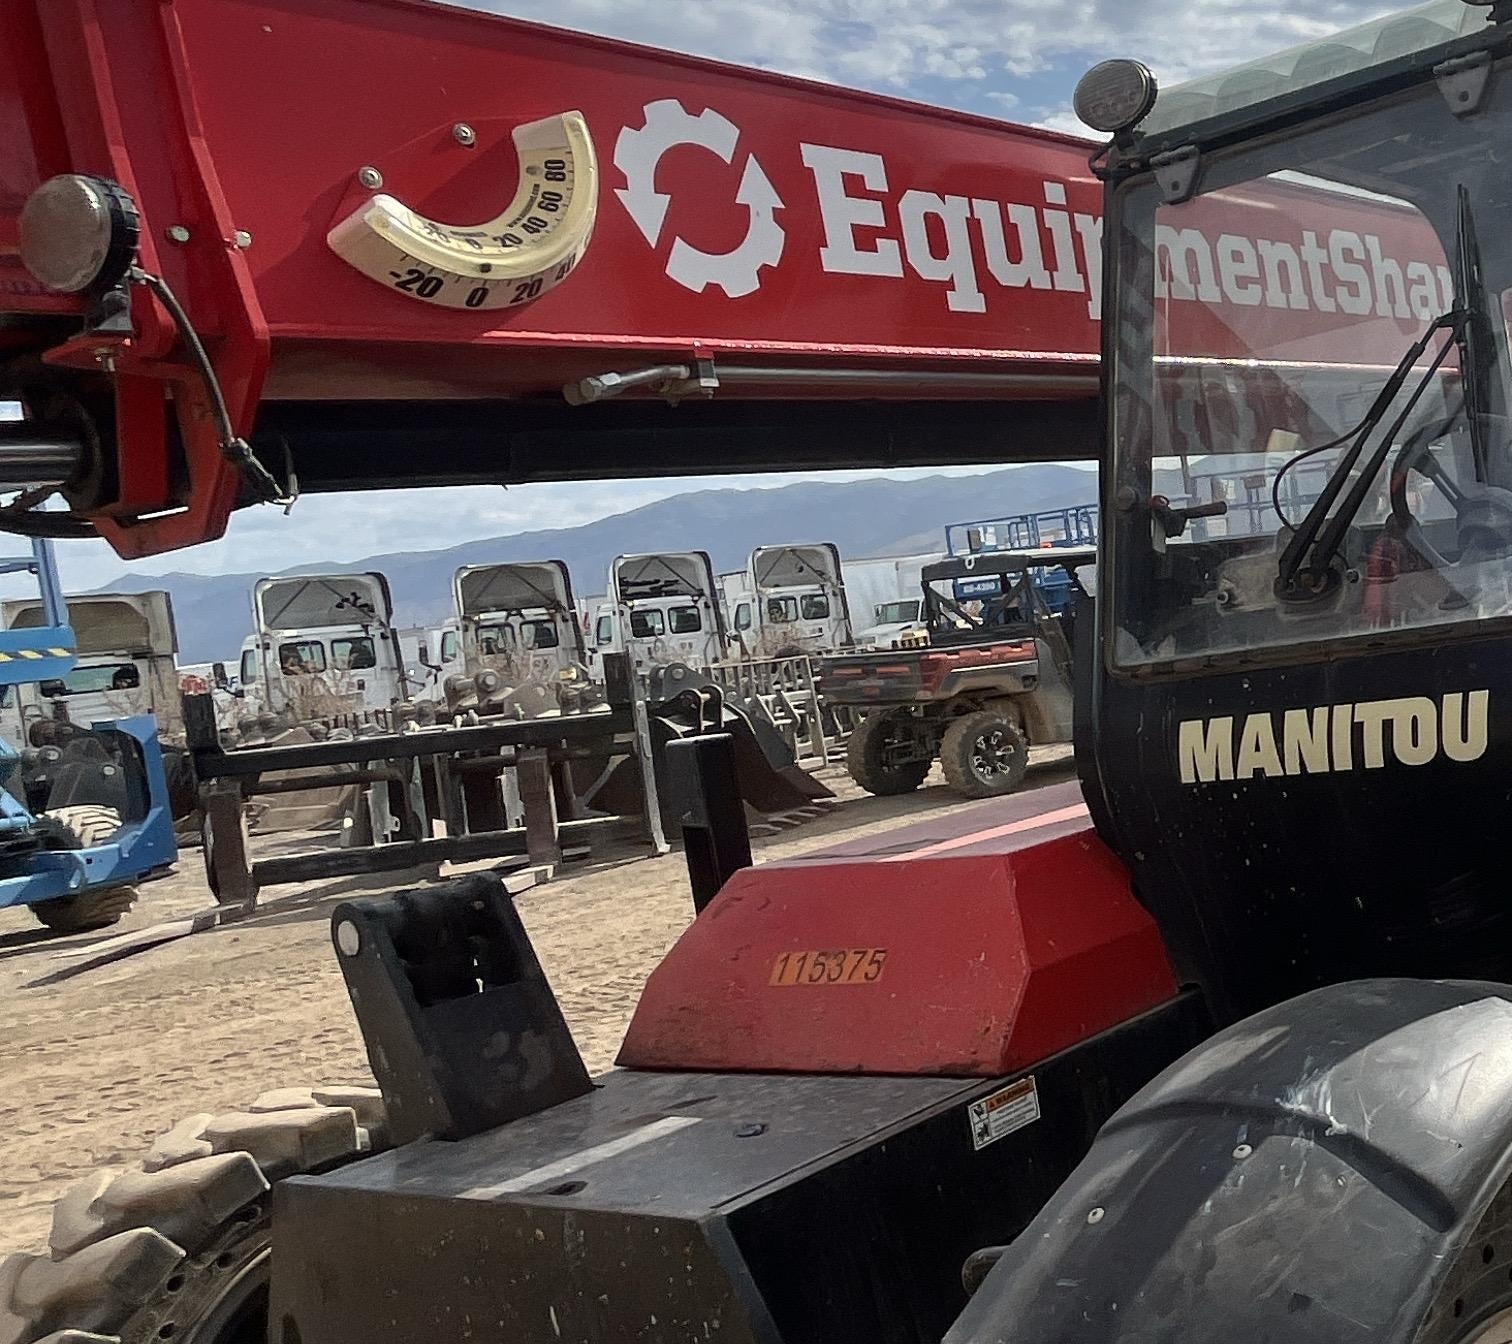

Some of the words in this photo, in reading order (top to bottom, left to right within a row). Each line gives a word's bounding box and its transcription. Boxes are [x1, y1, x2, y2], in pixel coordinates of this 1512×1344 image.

[544, 159, 566, 182] 80
[537, 190, 563, 213] 60
[521, 216, 548, 235] 40
[800, 143, 1454, 322] EquimentSha
[492, 232, 523, 248] 20
[390, 268, 444, 298] -20
[509, 277, 543, 305] 20
[465, 286, 489, 307] 0
[1178, 689, 1490, 784] MANITOU
[777, 949, 888, 984] 115375
